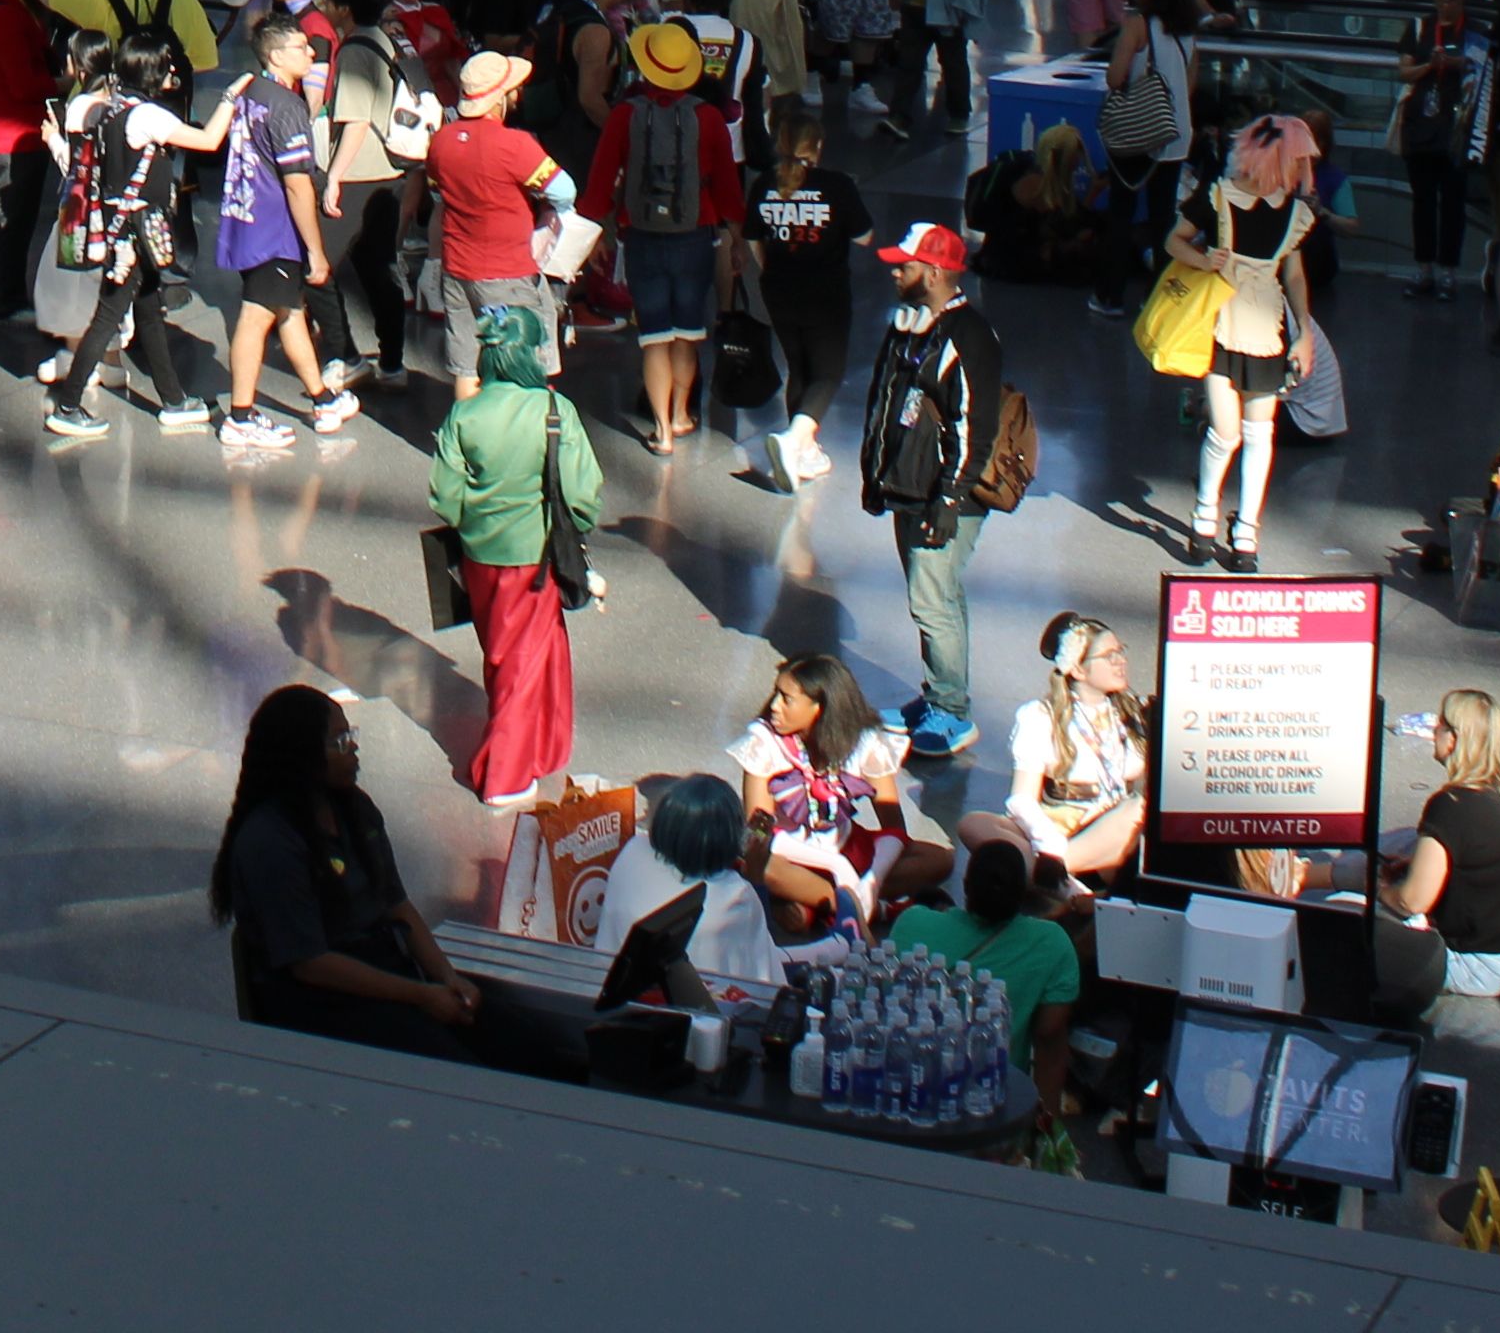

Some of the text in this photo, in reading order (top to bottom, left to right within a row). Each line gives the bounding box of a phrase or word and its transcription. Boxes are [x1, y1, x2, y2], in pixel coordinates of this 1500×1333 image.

[758, 202, 831, 227] STAFF
[1211, 589, 1366, 614] ALCOHOLIC DRINKS
[1211, 615, 1300, 638] SOLD HERE
[1210, 664, 1254, 676] PLEASE
[1258, 664, 1287, 676] HAVE
[1290, 664, 1322, 676] YOUR
[1209, 678, 1264, 690] ID READY
[1208, 711, 1240, 724] LIMIT
[1243, 712, 1251, 724] 2
[1255, 712, 1321, 724] ALCOHOLIC
[1207, 726, 1332, 739] DRINKS PER ID/VISIT
[1206, 749, 1251, 762] PLEASE
[1253, 750, 1287, 763] OPEN
[1289, 750, 1310, 763] ALL
[1206, 766, 1323, 779] ALCOHOLIC DRINKS
[1205, 781, 1317, 794] BEFORE YOU LEAVE
[577, 812, 620, 844] SMILE
[1203, 819, 1322, 836] CULTIVATED
[1260, 1199, 1303, 1219] SELF
